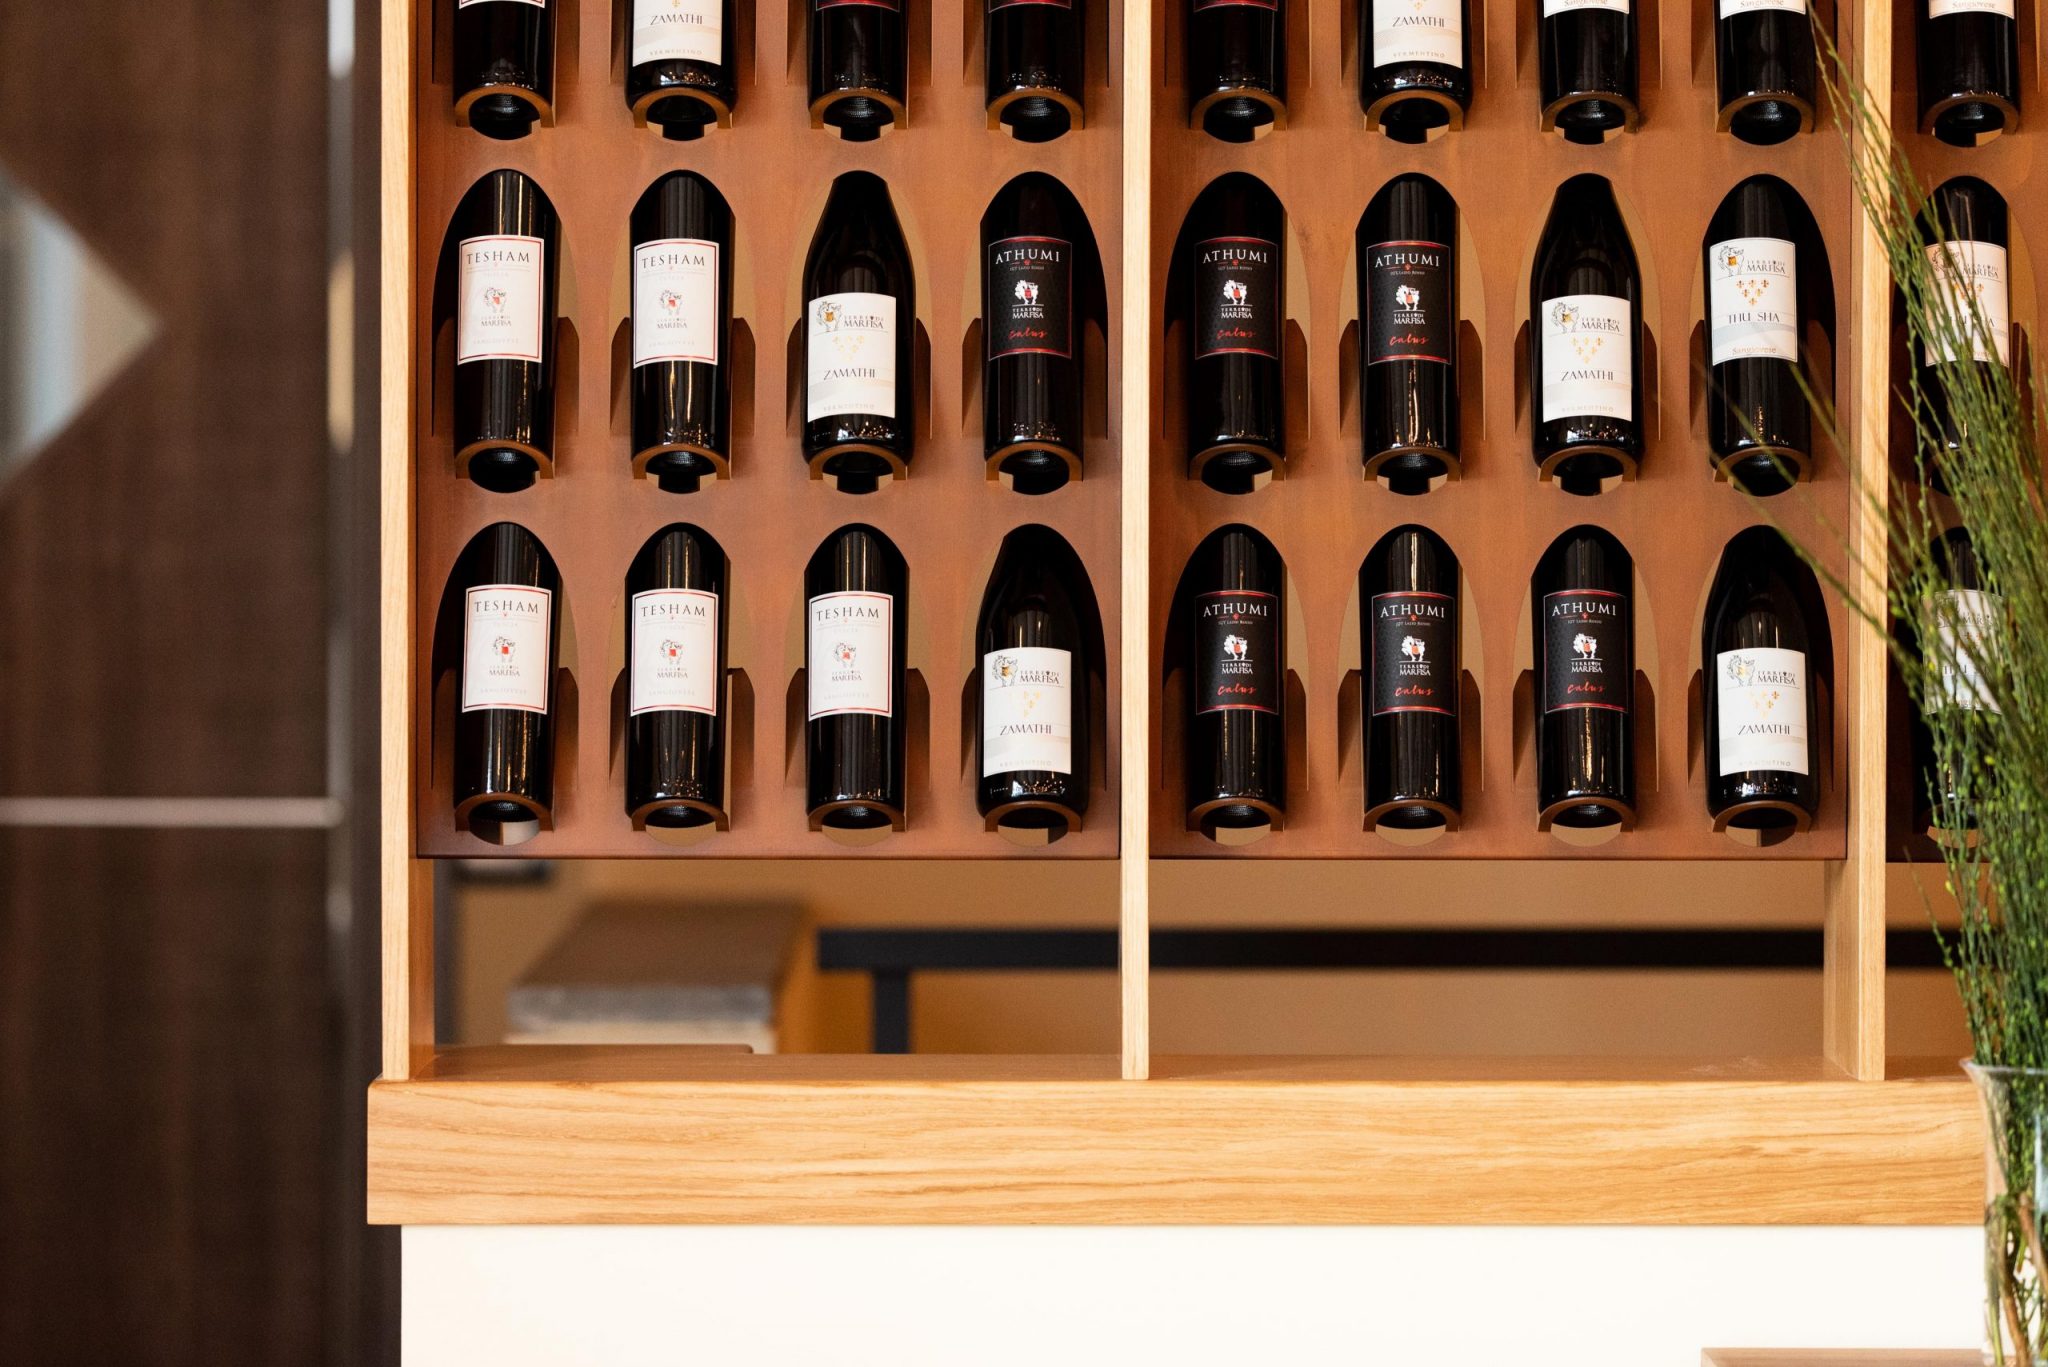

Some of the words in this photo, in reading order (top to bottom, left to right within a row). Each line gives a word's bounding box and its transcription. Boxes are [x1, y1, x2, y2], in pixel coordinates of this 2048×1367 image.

[650, 13, 702, 25] ZAMATHI
[1392, 16, 1444, 27] ZAMATHI
[467, 251, 530, 264] TESHAM
[642, 254, 705, 269] TESHAM
[995, 248, 1060, 265] ATHUMI
[1202, 248, 1268, 264] ATHUMI
[1375, 253, 1440, 268] ATHUMI
[1746, 264, 1786, 274] MARFISA
[1221, 311, 1253, 319] MARFISA
[1393, 317, 1426, 325] MARFISA
[1729, 312, 1750, 324] THU
[1757, 312, 1780, 322] SHA
[844, 320, 884, 329] MARFISA
[1581, 322, 1620, 332] MARFISA
[823, 368, 875, 380] ZAMATHI
[1561, 370, 1614, 381] ZAMATHI
[474, 600, 538, 614] TESHAM
[641, 604, 705, 617] TESHAM
[1203, 603, 1268, 617] ATHUMI
[1380, 604, 1445, 618] ATHUMI
[1552, 601, 1617, 617] ATHUMI
[816, 607, 879, 621] TESHAM
[1399, 668, 1431, 676] MARFISA
[1020, 674, 1059, 684] MARFISA
[1757, 675, 1796, 686] MARFISA
[1000, 724, 1052, 736] ZAMATHI
[1738, 724, 1790, 735] ZAMATHI
